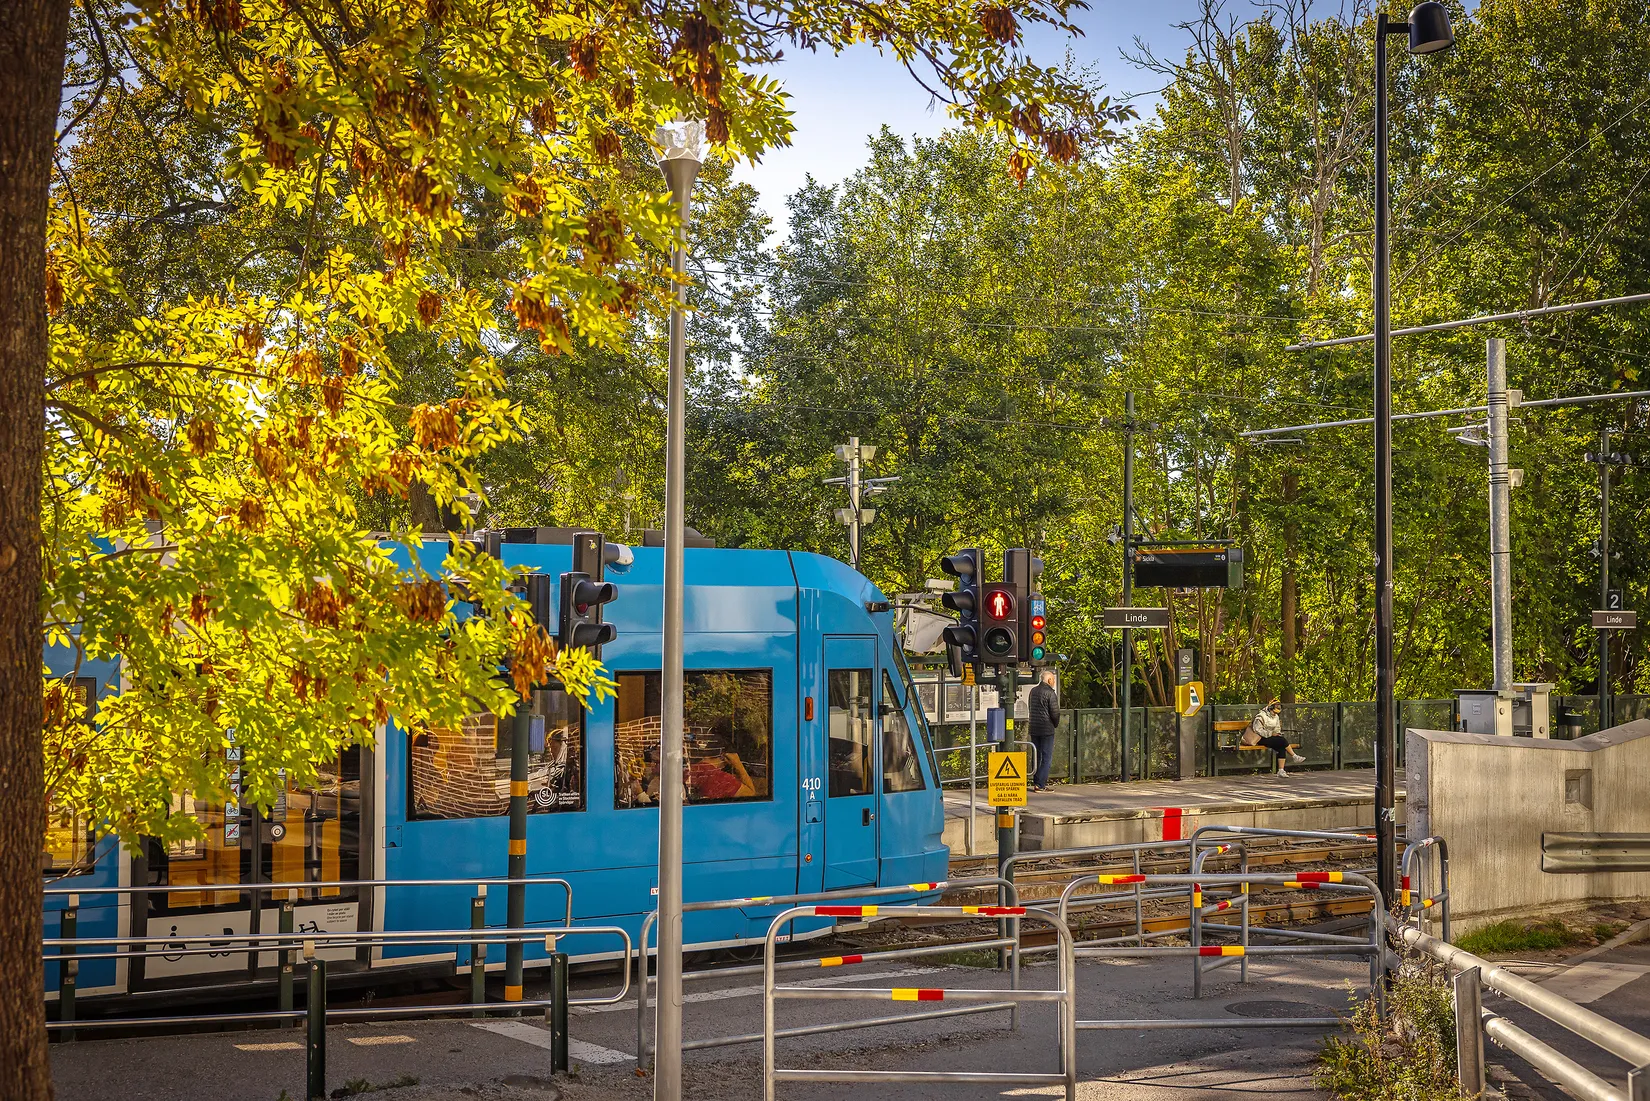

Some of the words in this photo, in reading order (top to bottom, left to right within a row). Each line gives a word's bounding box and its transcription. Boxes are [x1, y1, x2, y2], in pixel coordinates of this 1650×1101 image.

[1610, 594, 1619, 608] 2
[1125, 613, 1147, 622] Linde
[1606, 615, 1622, 623] Linde
[802, 778, 821, 790] 410
[810, 791, 815, 800] A
